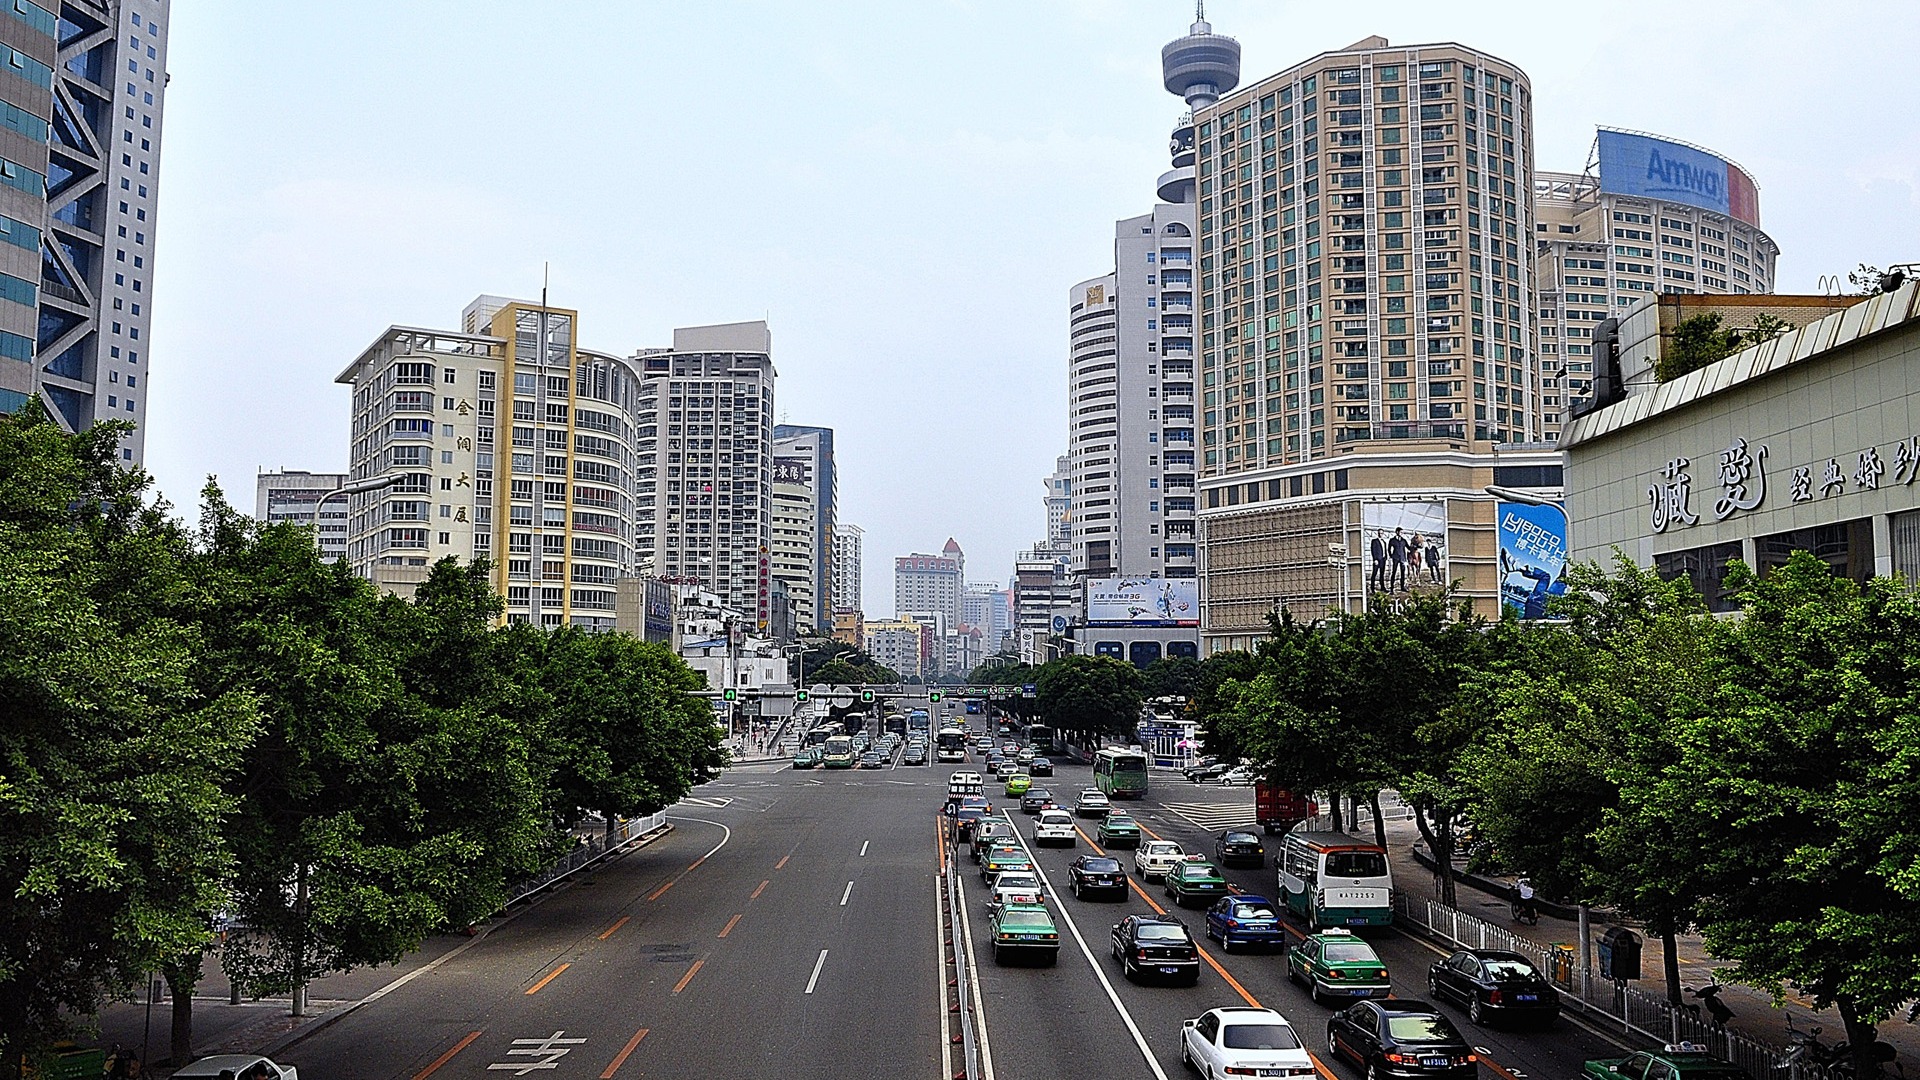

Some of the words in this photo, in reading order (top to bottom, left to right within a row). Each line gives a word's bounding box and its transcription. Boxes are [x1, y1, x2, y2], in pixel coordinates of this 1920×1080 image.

[1646, 147, 1724, 205] Amway
[1521, 528, 1567, 559] YOUTH
[1522, 520, 1561, 546] BOCO
